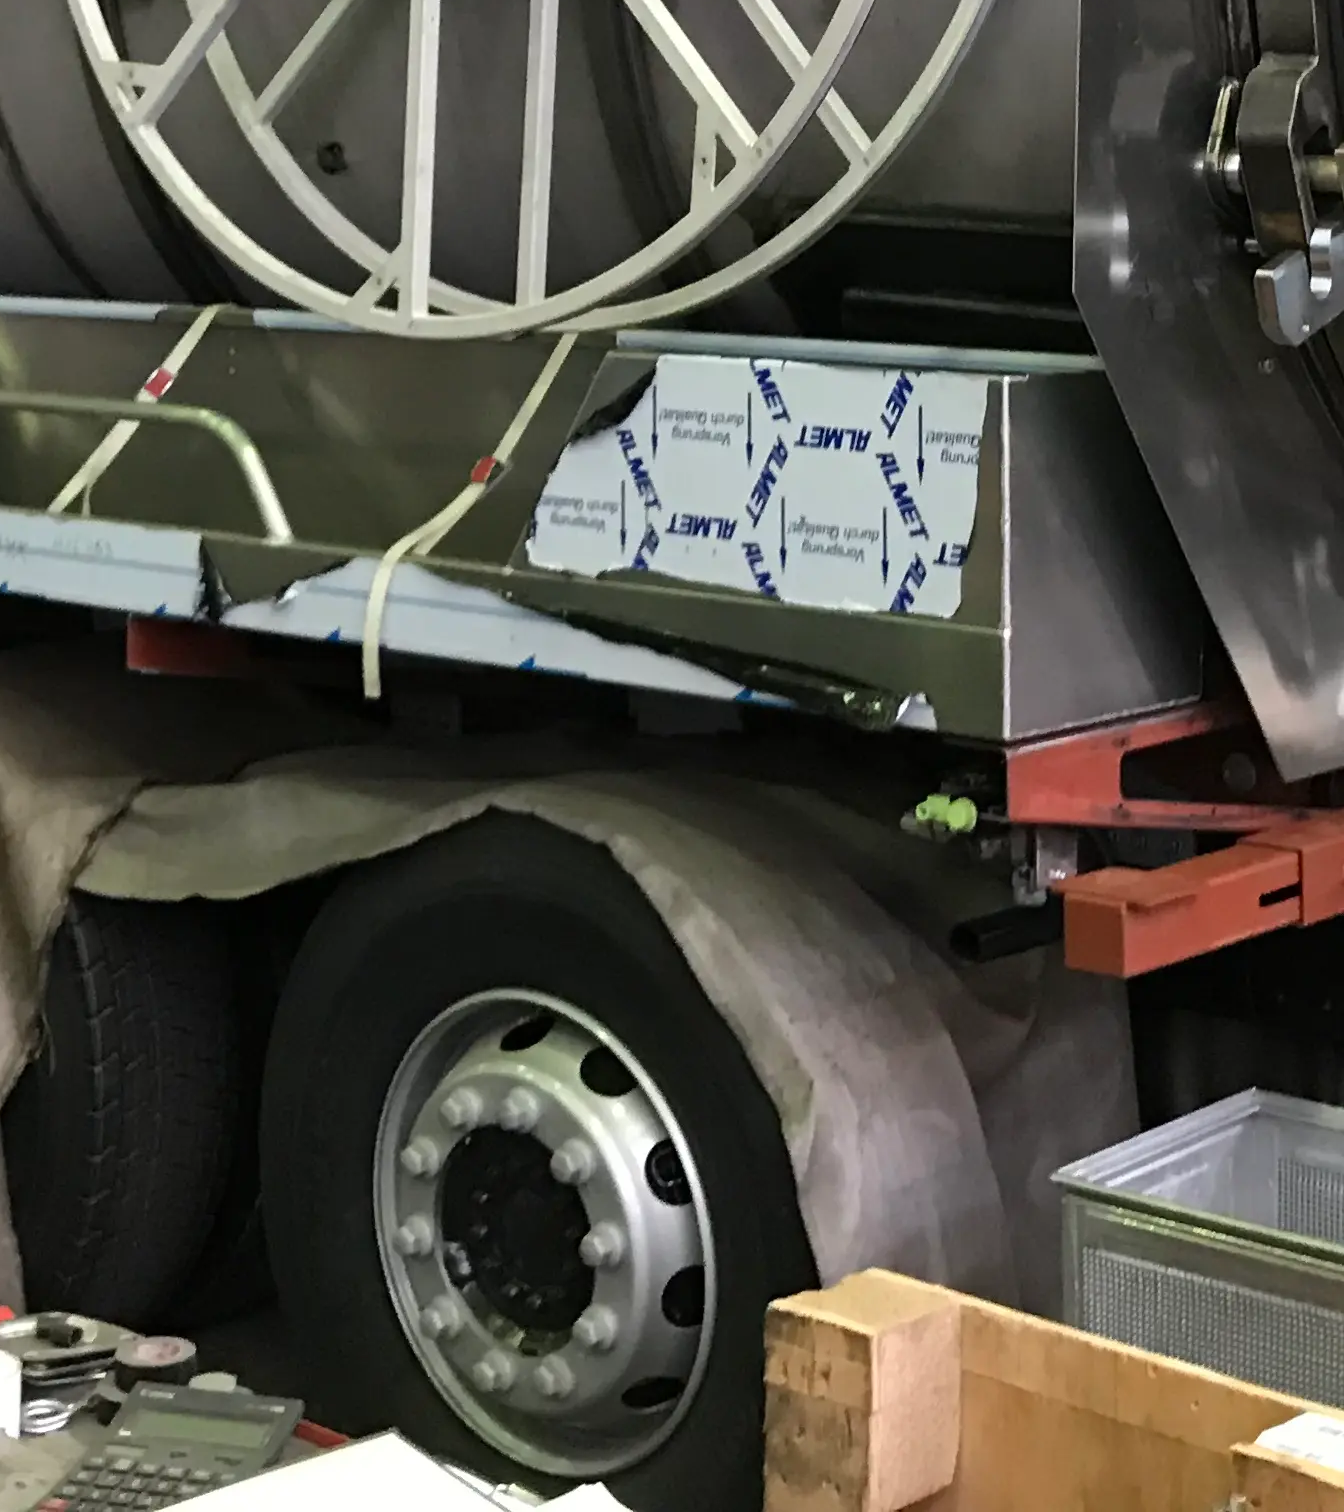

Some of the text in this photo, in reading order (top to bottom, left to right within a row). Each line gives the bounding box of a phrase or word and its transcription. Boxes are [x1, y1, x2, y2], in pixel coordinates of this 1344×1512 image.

[615, 427, 663, 511] ALMET
[745, 433, 789, 529] ALMET
[794, 425, 873, 453] ALMET
[665, 512, 738, 541] ALMET
[875, 451, 931, 541] ALMET
